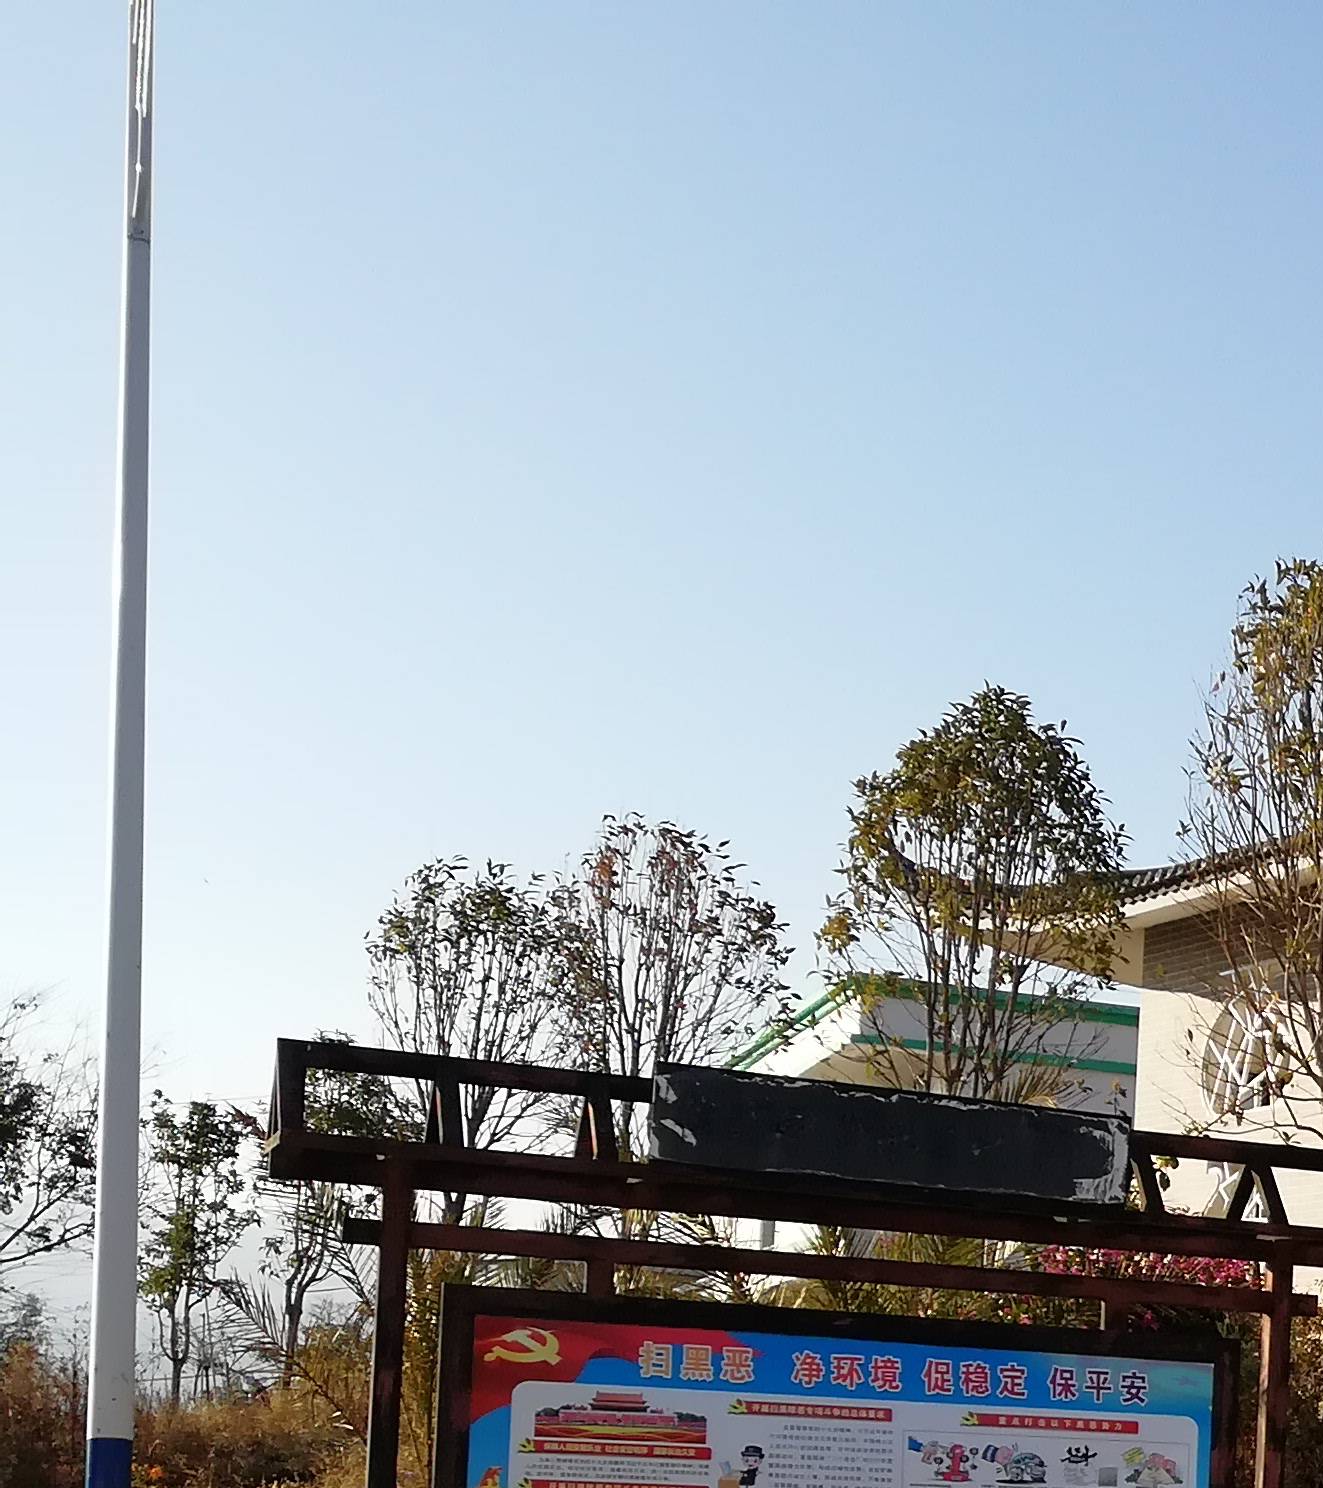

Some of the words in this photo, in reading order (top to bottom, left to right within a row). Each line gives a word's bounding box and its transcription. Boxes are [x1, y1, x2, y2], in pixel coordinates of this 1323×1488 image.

[639, 1341, 755, 1383] 扫黑恶
[790, 1349, 902, 1392] 净环境
[921, 1358, 1028, 1400] 促稳定
[1046, 1365, 1149, 1408] 保平安
